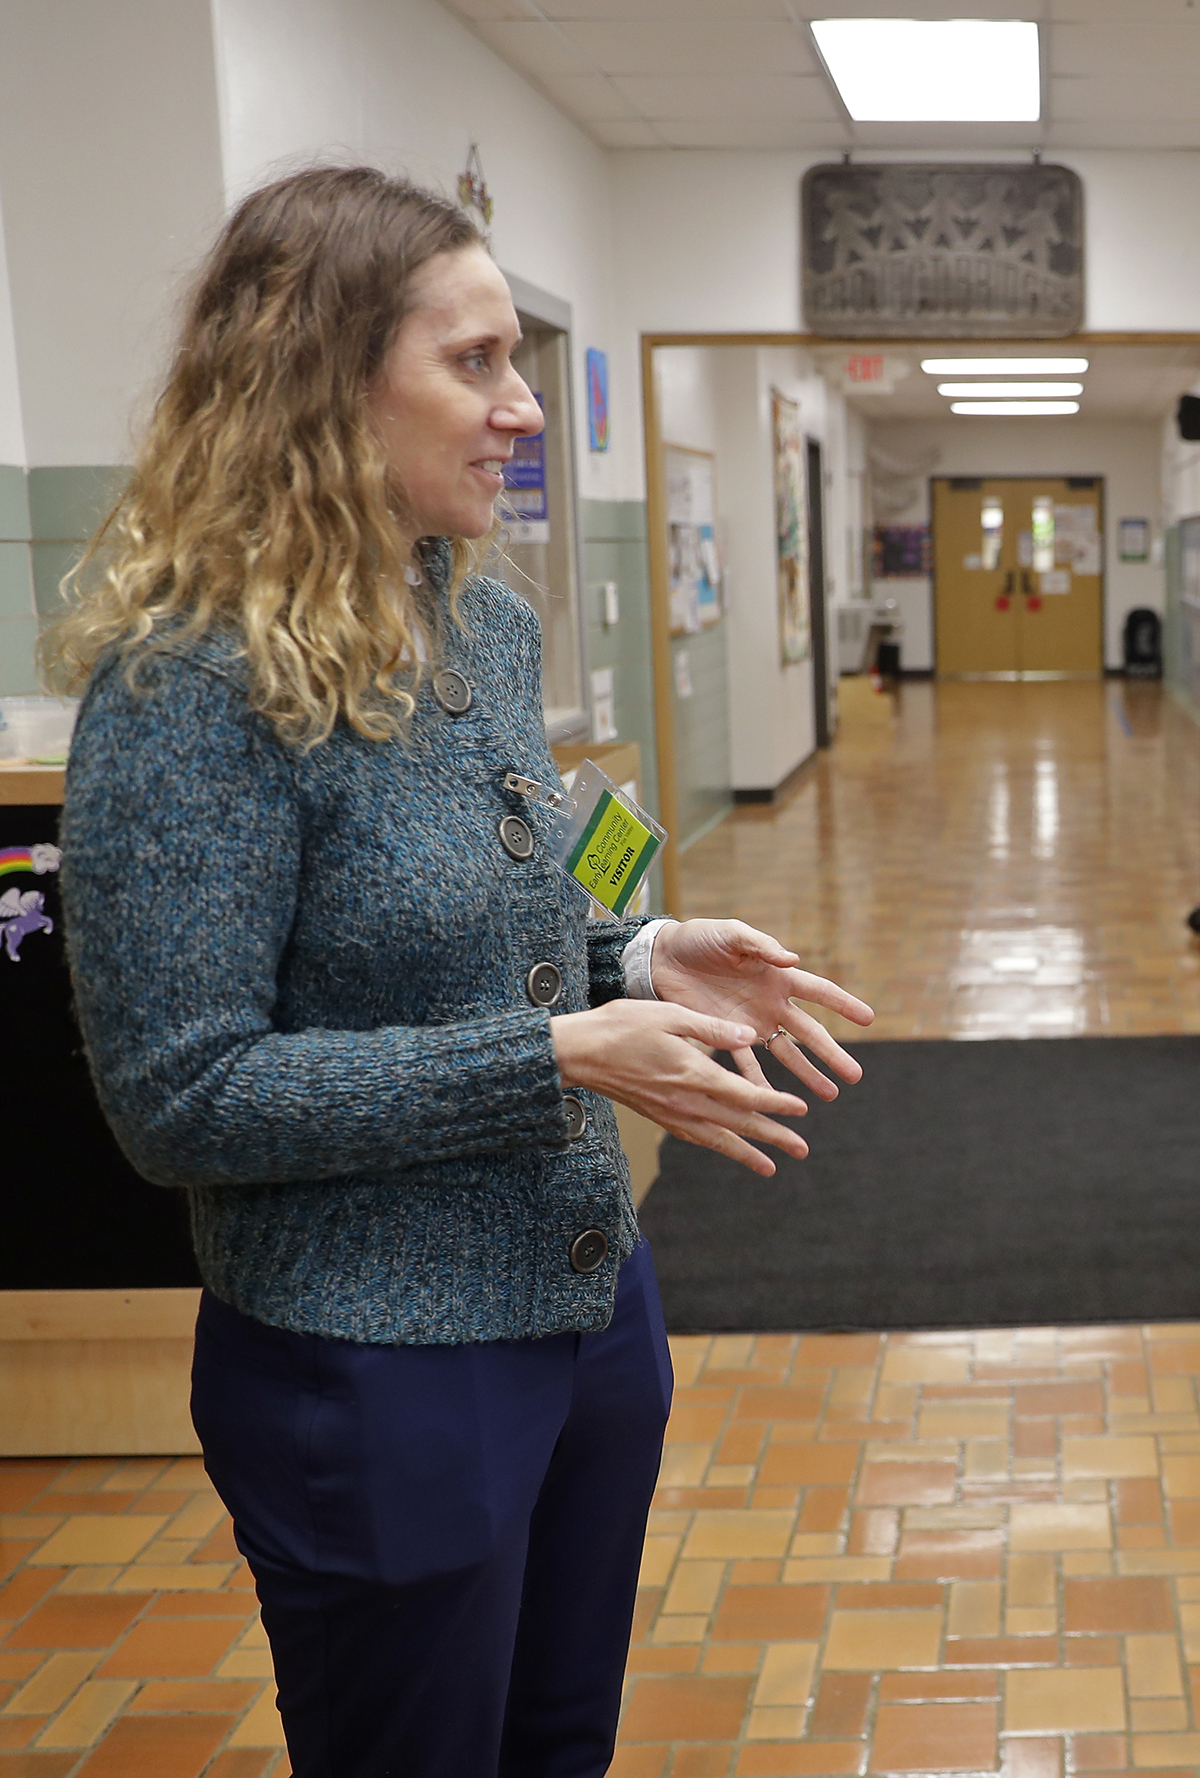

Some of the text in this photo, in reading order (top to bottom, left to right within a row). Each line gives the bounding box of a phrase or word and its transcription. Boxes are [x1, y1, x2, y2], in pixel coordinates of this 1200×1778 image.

[849, 354, 884, 382] EXIT
[596, 812, 622, 854] Community
[589, 870, 603, 889] Early
[612, 819, 629, 842] Center
[609, 846, 635, 886] VISITOR
